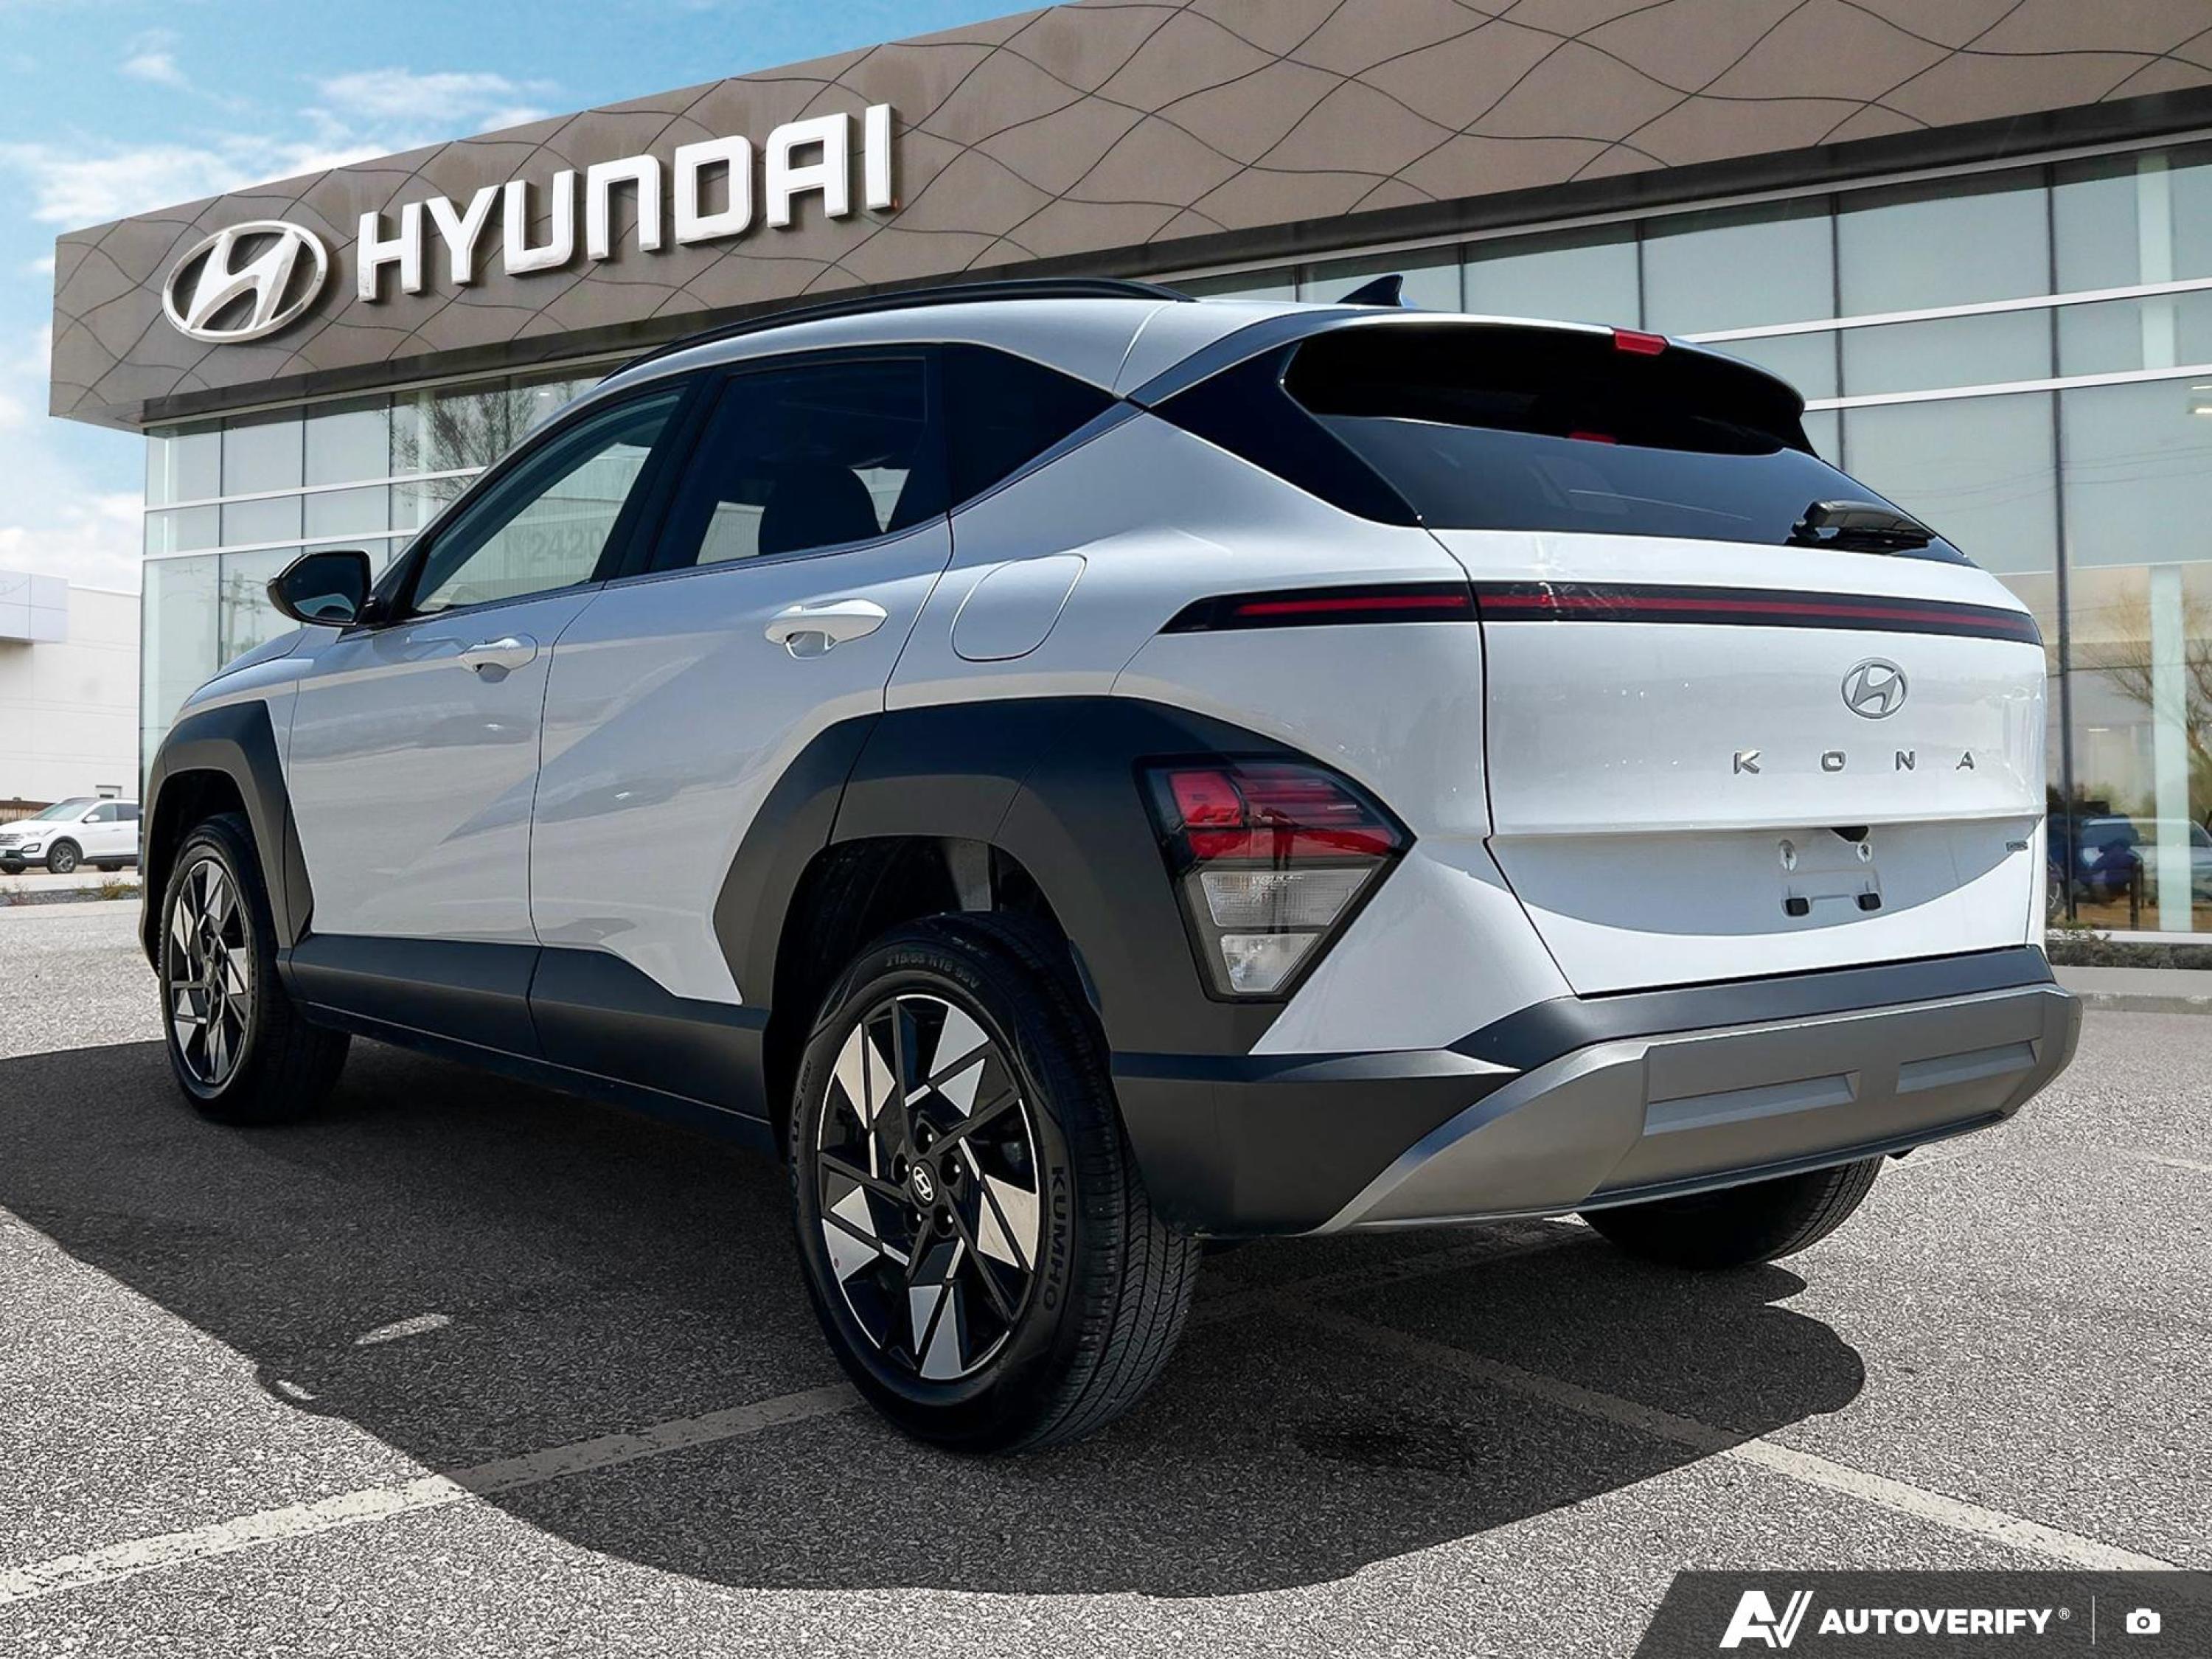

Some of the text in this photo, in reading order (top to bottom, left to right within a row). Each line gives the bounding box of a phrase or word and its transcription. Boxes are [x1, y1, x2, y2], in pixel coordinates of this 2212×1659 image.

[358, 103, 891, 302] HYUNDAI
[1733, 751, 1975, 774] KONA
[1043, 1166, 1066, 1311] KUMHO
